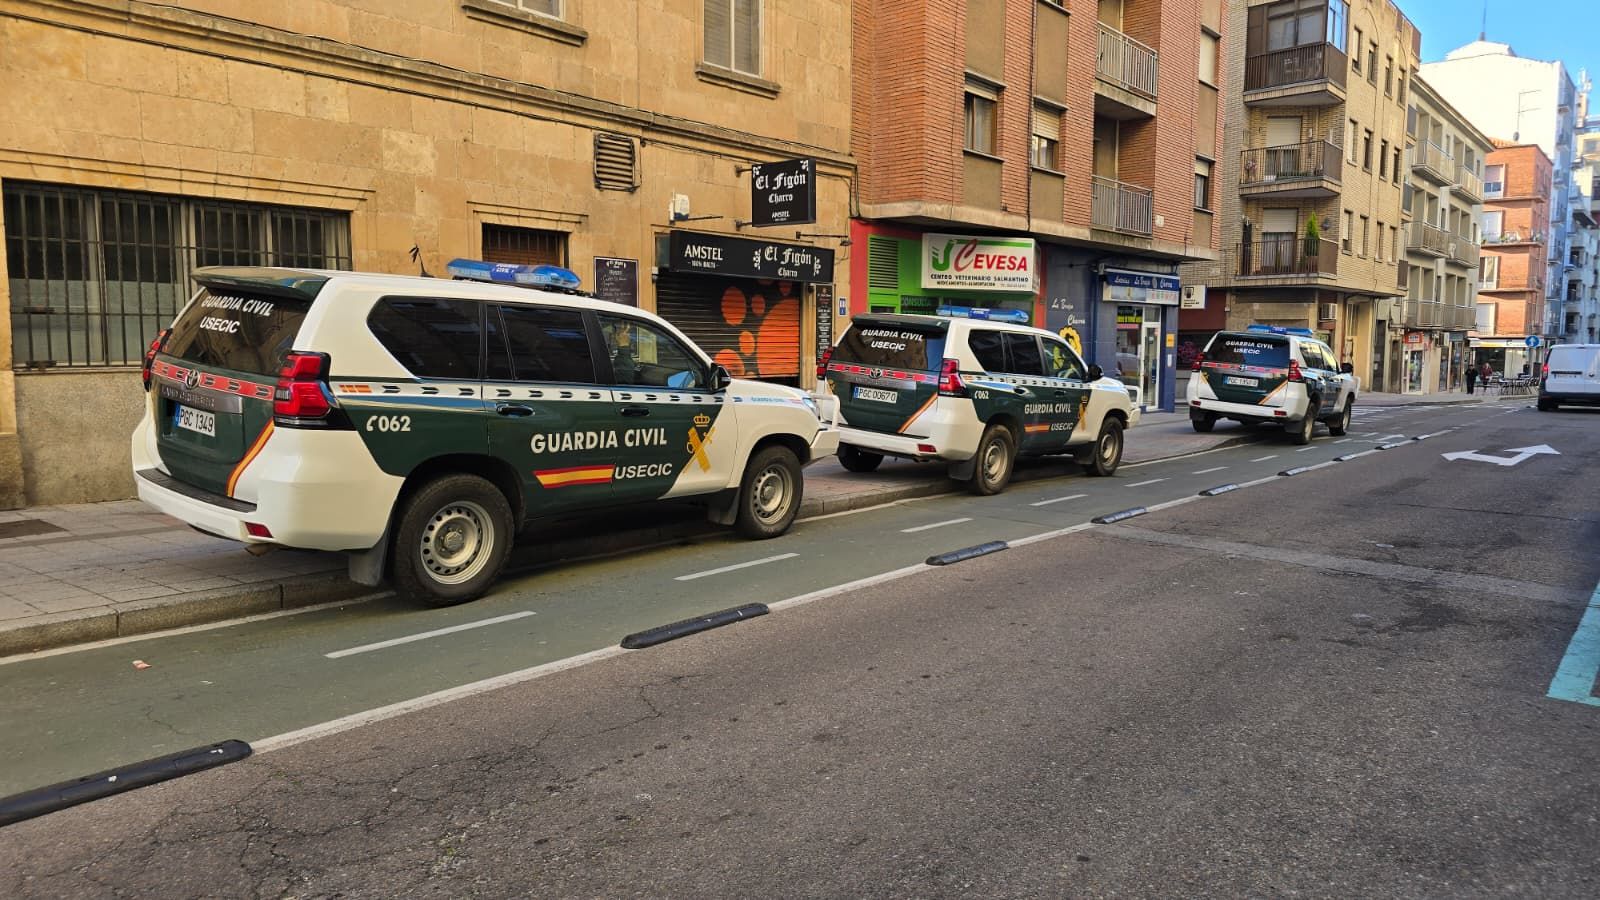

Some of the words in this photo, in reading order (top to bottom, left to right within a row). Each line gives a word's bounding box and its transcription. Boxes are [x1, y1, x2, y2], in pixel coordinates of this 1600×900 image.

[756, 174, 769, 190] El
[772, 170, 806, 190] Figón
[768, 193, 793, 204] Charro
[772, 210, 790, 219] AMSTEL
[684, 244, 724, 261] AMSTEL
[764, 245, 778, 261] El
[780, 248, 812, 266] Figón
[954, 239, 1028, 272] CEVESA
[777, 267, 798, 278] Charro
[930, 273, 953, 281] CENTRO
[201, 296, 243, 311] GUARDIA
[243, 300, 274, 317] CIVIL
[200, 316, 240, 334] USECIC
[861, 329, 899, 337] GUARDIA
[900, 332, 924, 341] CIVIL
[871, 340, 906, 351] USECIC
[859, 388, 872, 398] PGC
[1024, 403, 1054, 414] GUARDIA
[1055, 403, 1072, 413] CIVIL
[179, 409, 194, 427] PGC
[195, 413, 214, 432] 1349
[1051, 422, 1073, 431] USECIC
[531, 430, 618, 454] GUARDIA
[624, 427, 667, 447] CIVIL
[614, 463, 673, 480] USECIC
